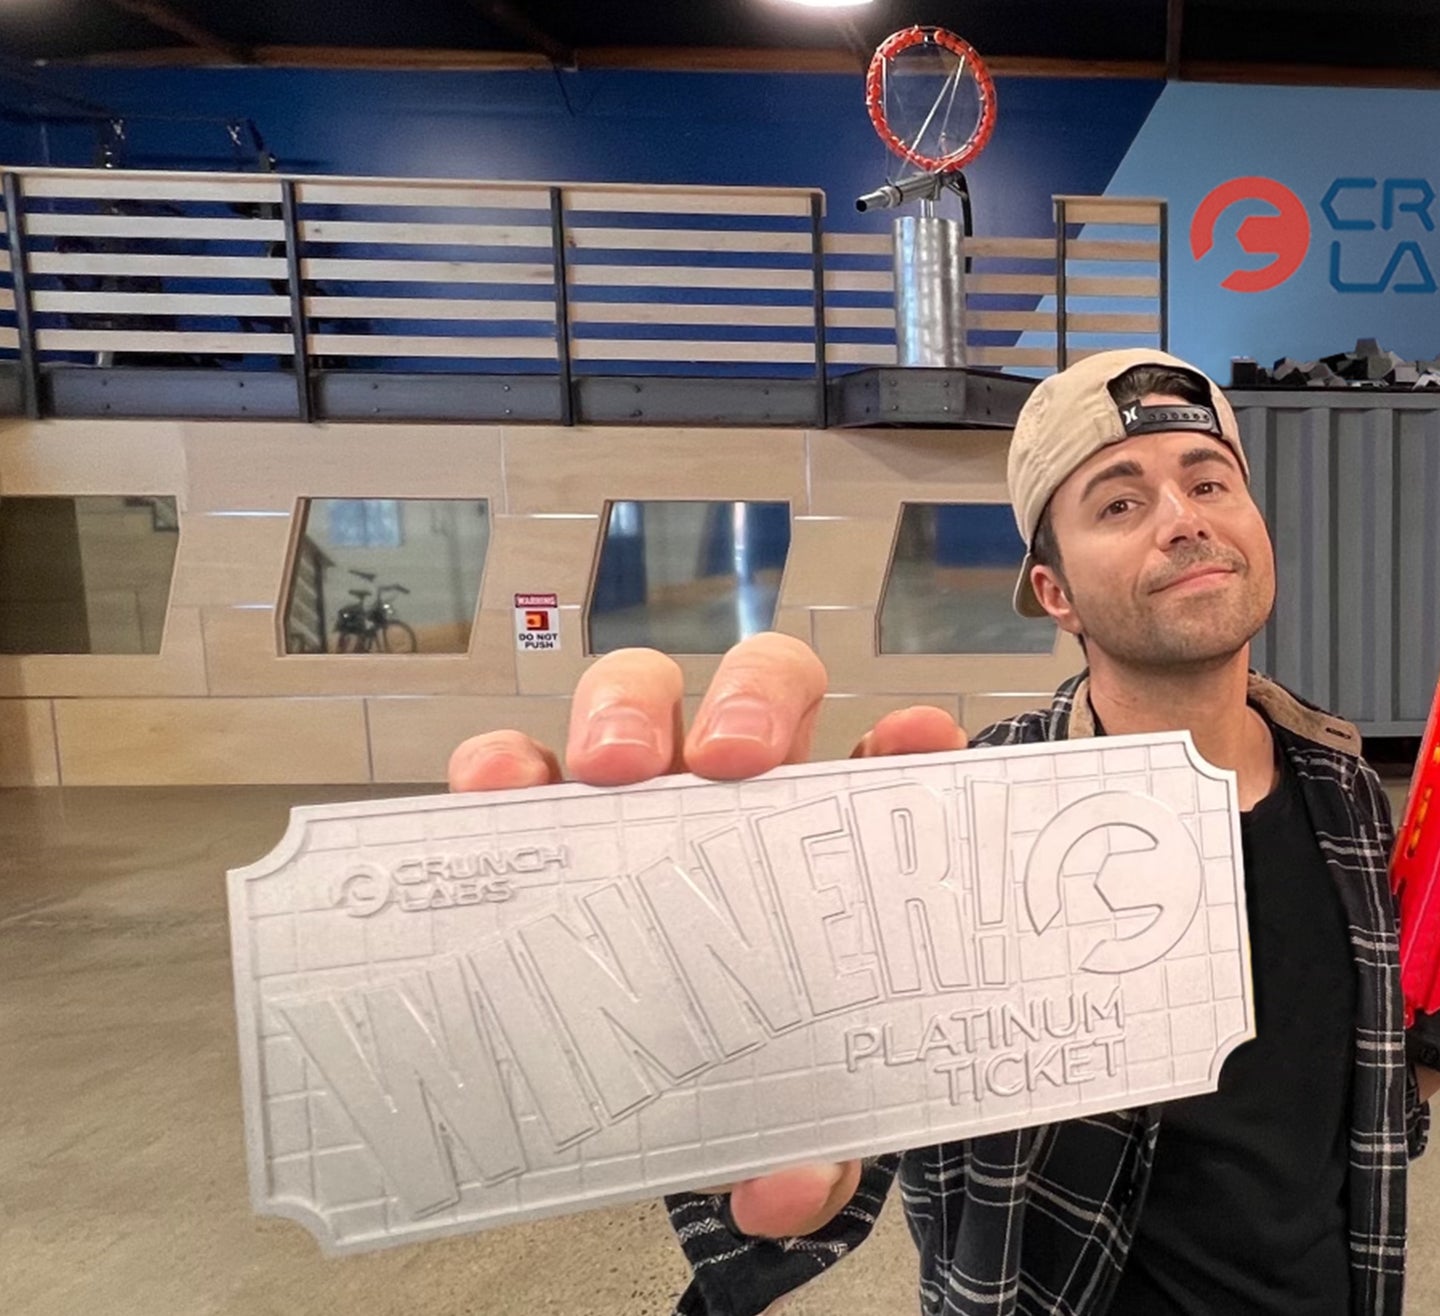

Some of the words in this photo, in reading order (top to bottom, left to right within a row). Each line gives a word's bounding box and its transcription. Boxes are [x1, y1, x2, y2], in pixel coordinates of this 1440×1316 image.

[518, 633, 534, 641] DO
[536, 633, 557, 641] NOT
[525, 641, 554, 649] PUSH
[391, 845, 570, 886] CRUNCH
[400, 880, 515, 913] LABS
[272, 774, 1010, 1214] WINNER!
[844, 985, 1124, 1074] PLATINUM
[933, 1032, 1127, 1106] TICKET
